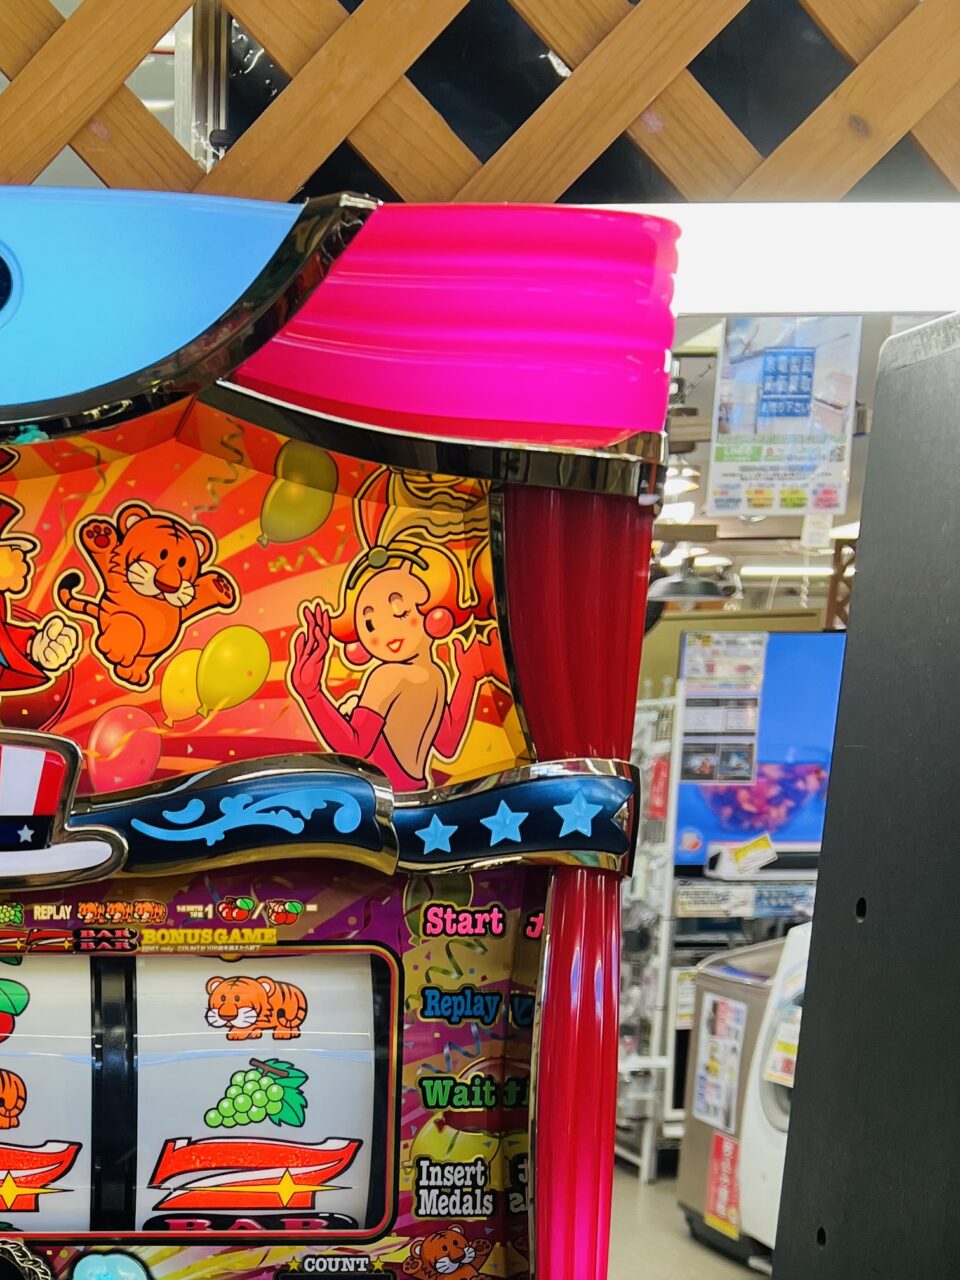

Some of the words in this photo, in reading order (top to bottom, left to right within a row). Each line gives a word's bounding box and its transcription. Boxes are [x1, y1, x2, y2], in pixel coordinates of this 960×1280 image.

[33, 904, 72, 921] REPLAY
[204, 903, 213, 919] 1
[425, 906, 504, 935] Start
[141, 928, 213, 946] BONUS
[214, 928, 278, 945] GAME
[424, 989, 499, 1024] Replay
[421, 1078, 496, 1107] Wait
[418, 1159, 485, 1187] Insert
[417, 1188, 494, 1216] Medals
[303, 1257, 369, 1273] COUNT
